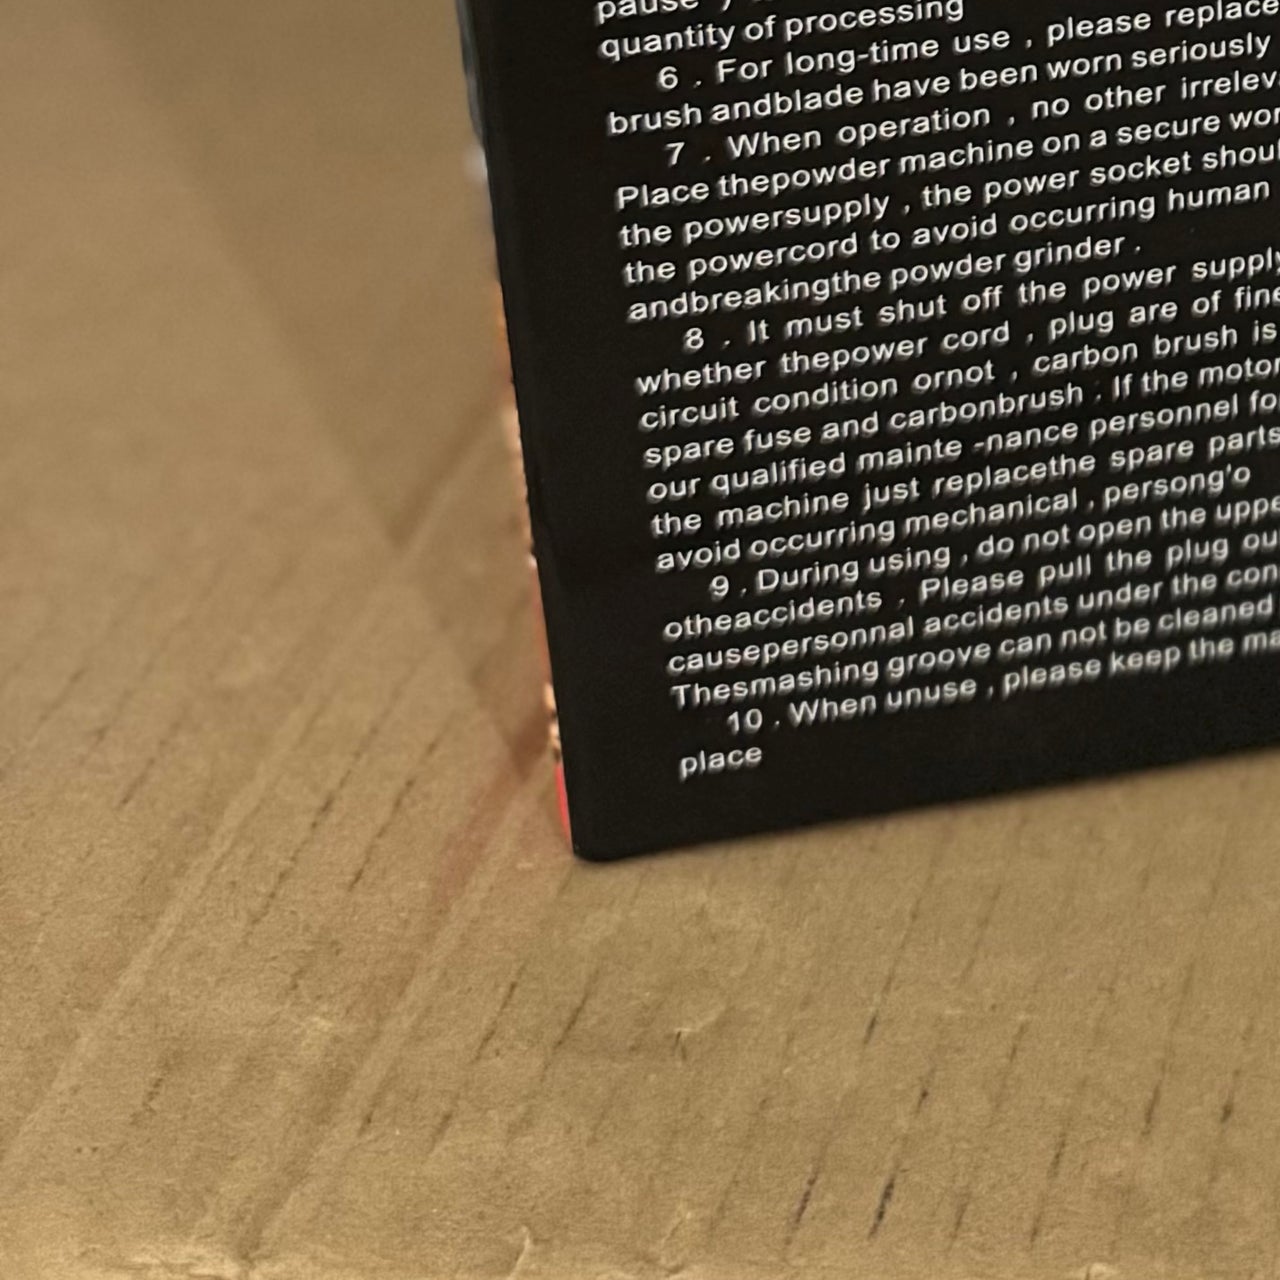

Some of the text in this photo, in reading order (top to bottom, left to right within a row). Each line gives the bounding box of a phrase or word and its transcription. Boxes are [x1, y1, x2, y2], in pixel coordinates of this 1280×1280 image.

[598, 22, 736, 63] quantity
[742, 13, 777, 42] of
[607, 31, 1272, 135] brush andblade have been worn seriously
[615, 181, 710, 211] Place
[716, 156, 892, 198] thepowder
[897, 138, 1034, 175] machine
[1041, 132, 1081, 155] on
[1088, 128, 1108, 149] a
[1114, 114, 1222, 145] secure
[622, 259, 677, 285] the
[686, 231, 858, 283] powercord
[869, 228, 901, 252] to
[911, 212, 998, 247] avoid
[1008, 195, 1156, 234] occurring
[1167, 180, 1271, 213] human
[627, 235, 1126, 323] andbreakingthe powder grinder
[650, 511, 702, 537] the
[715, 491, 850, 528] machine
[862, 476, 921, 515] just
[932, 453, 1097, 497] replacethe
[1109, 439, 1195, 472] spare
[655, 537, 742, 572] avoid
[747, 519, 896, 559] occurring
[903, 486, 1078, 536] mechanical
[670, 659, 880, 708] Thesmashing
[886, 642, 992, 680] groove
[998, 632, 1053, 657] can
[1060, 620, 1107, 648] not
[1114, 616, 1151, 639] be
[1158, 593, 1274, 631] cleaned
[679, 746, 763, 781] place
